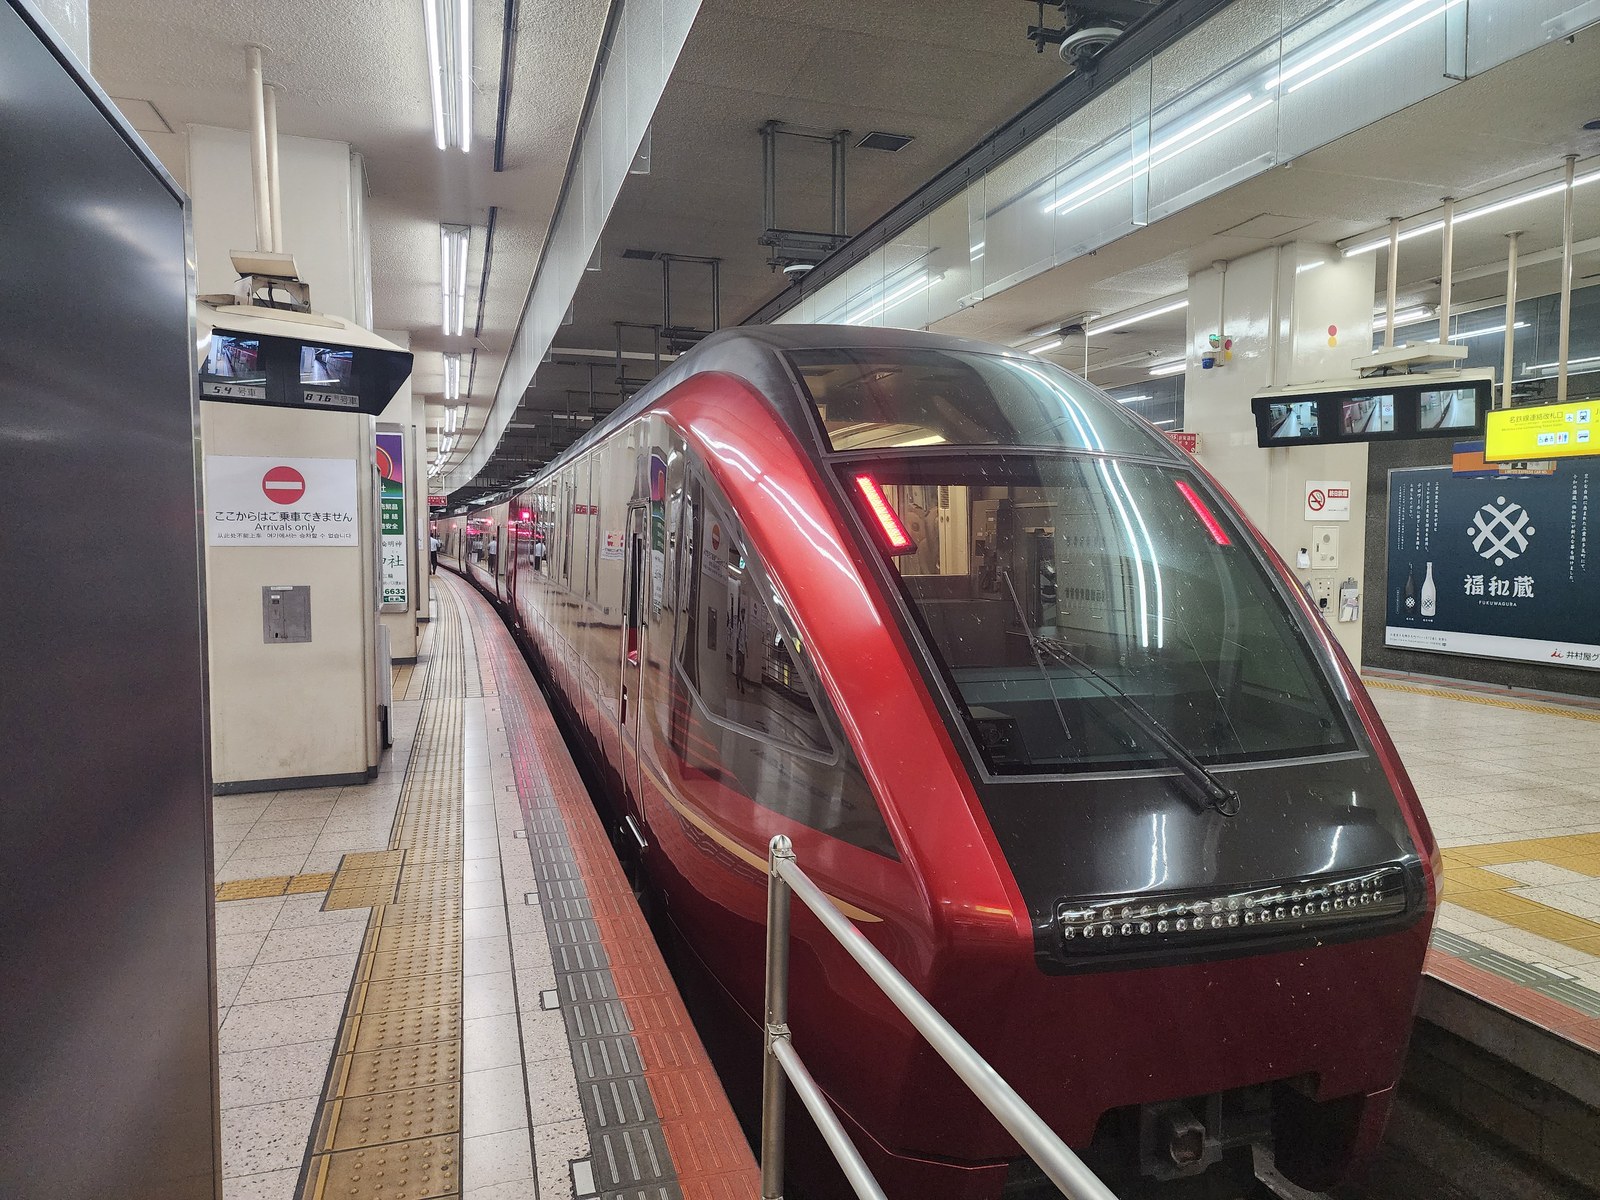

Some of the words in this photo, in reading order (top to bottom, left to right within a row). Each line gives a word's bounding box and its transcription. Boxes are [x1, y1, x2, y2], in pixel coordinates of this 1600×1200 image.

[214, 511, 353, 523] ここからはご乗車できません
[254, 522, 292, 531] Arrivals
[295, 522, 316, 533] only
[1463, 574, 1535, 598] 福和蔵
